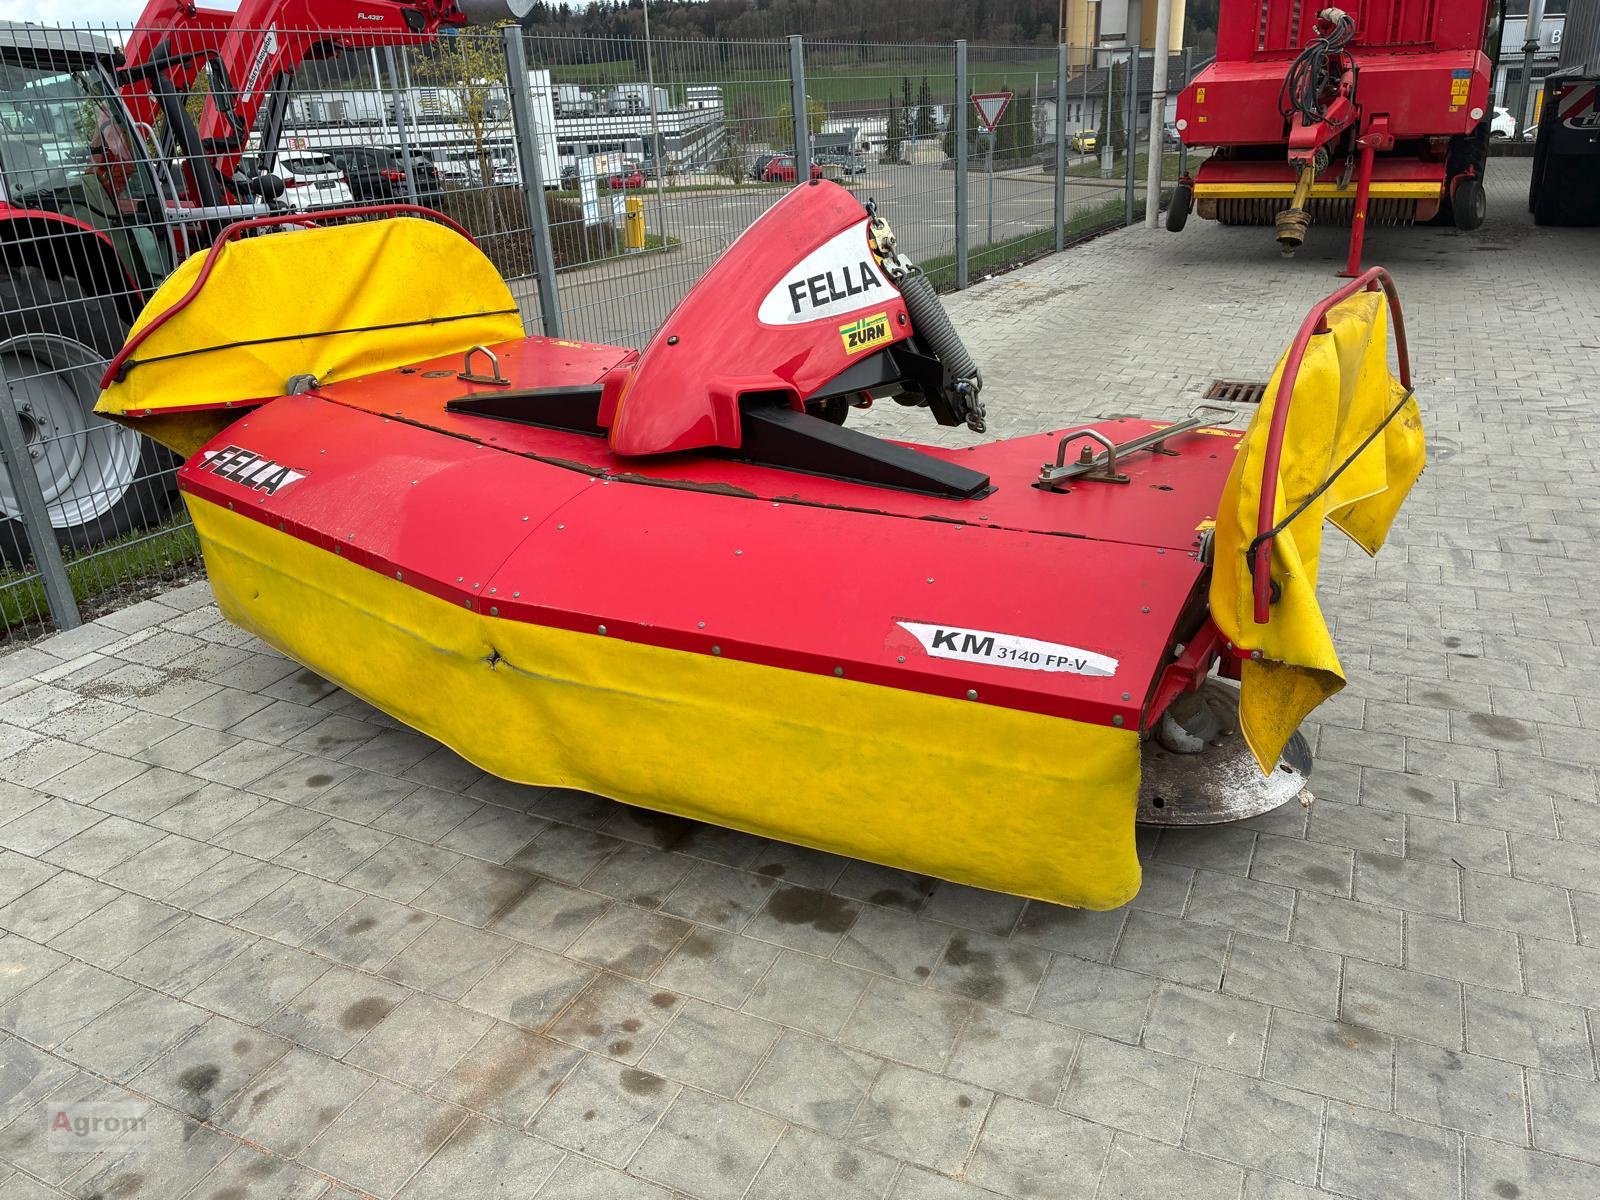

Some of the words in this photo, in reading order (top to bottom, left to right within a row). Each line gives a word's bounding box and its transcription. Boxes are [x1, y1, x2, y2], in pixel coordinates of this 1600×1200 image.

[788, 261, 882, 314] FELLA
[199, 445, 291, 496] FELLA
[931, 629, 995, 656] KM
[997, 647, 1040, 664] 3140
[1045, 655, 1087, 671] FP-V
